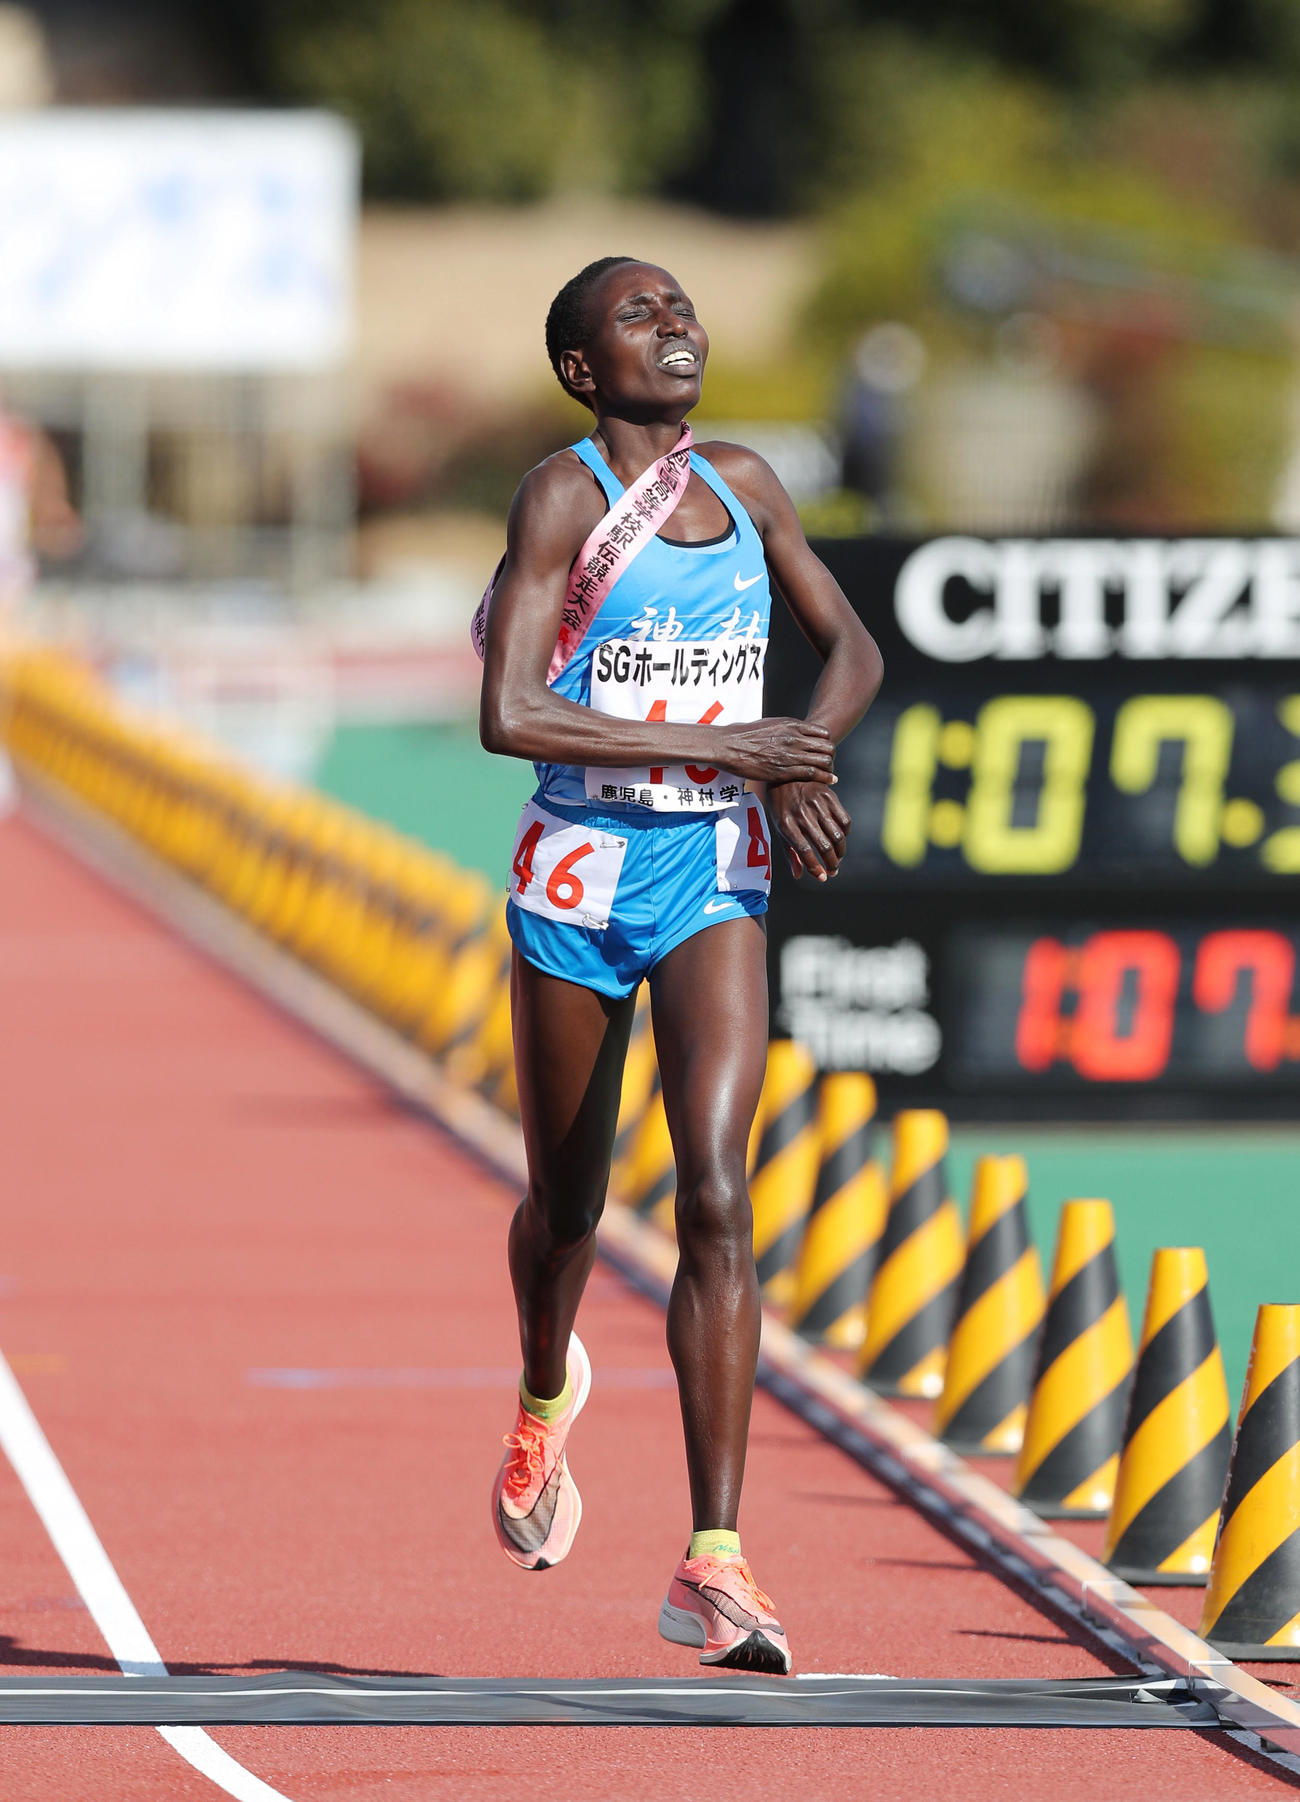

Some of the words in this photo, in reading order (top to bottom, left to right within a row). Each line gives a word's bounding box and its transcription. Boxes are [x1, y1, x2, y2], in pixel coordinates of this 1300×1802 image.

[597, 643, 762, 687] SGホールディングス
[512, 820, 595, 910] 46
